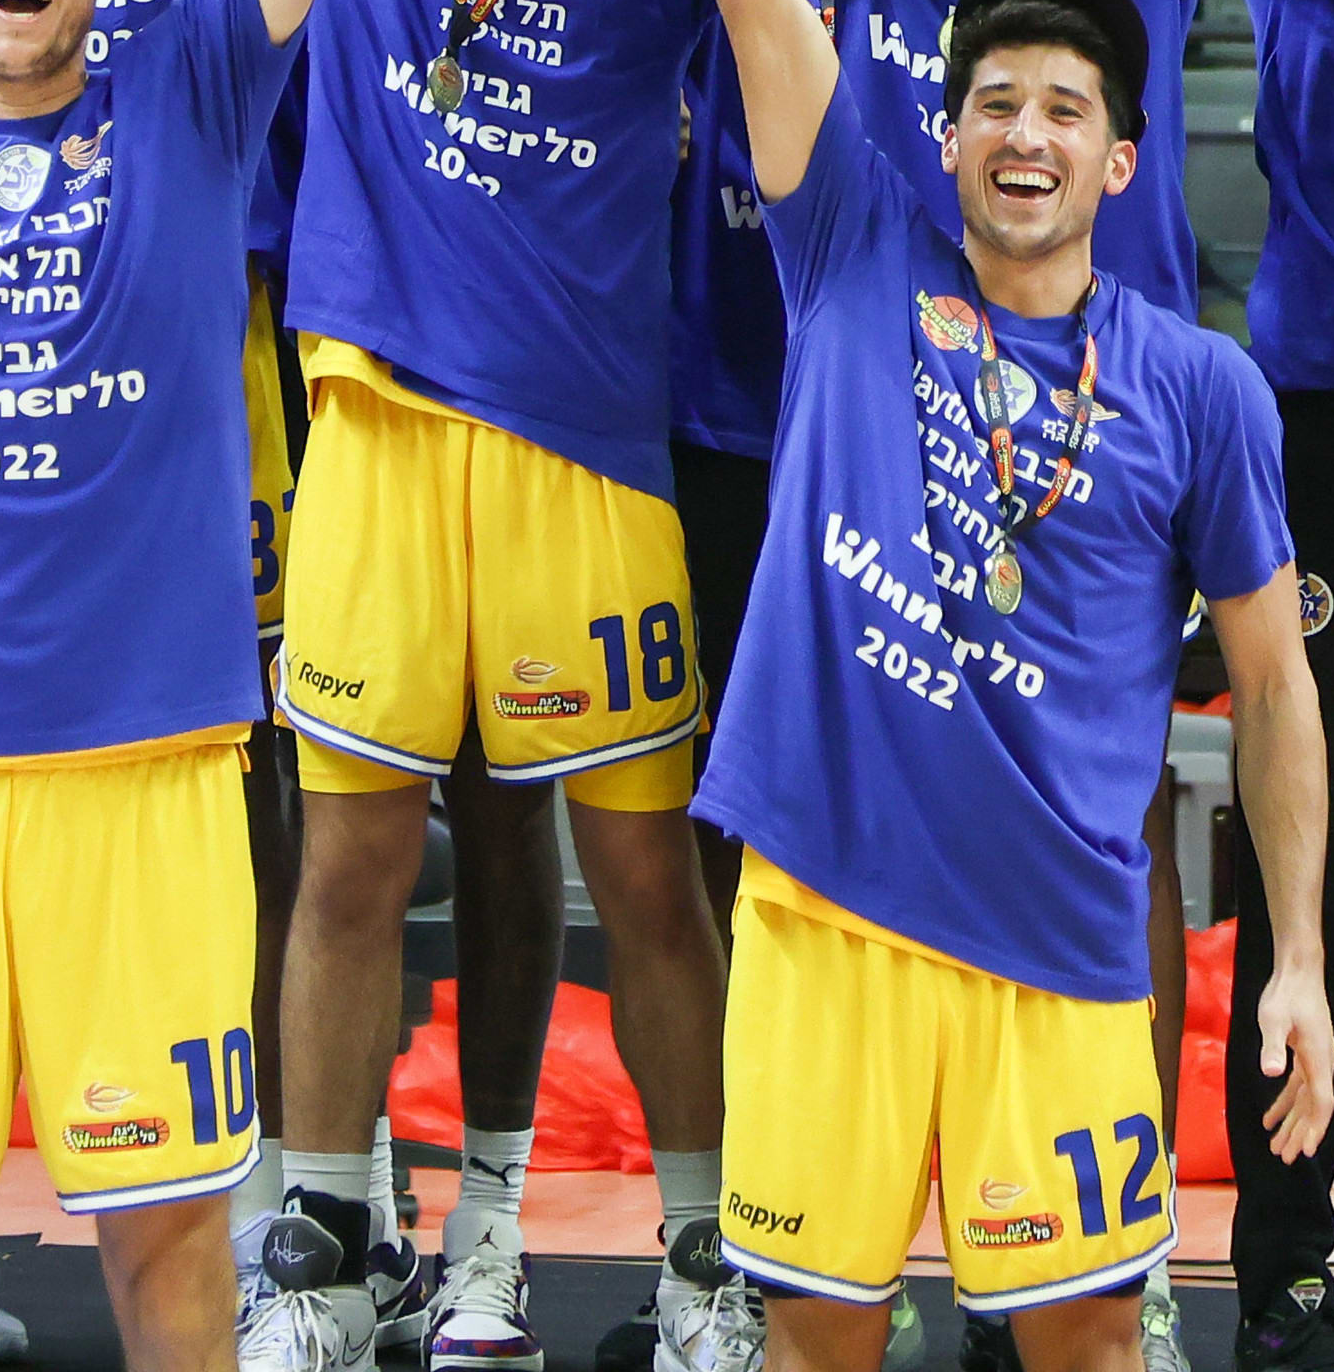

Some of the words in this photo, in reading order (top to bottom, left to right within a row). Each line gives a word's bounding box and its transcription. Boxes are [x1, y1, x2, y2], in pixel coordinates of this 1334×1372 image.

[544, 127, 598, 169] סל
[27, 245, 81, 278] תל
[89, 368, 147, 409] סל
[822, 512, 985, 668] Winnr
[988, 639, 1046, 699] סל
[588, 600, 687, 713] 18
[855, 625, 961, 712] 2022
[297, 660, 366, 700] Rapyd
[500, 697, 564, 716] Winner
[170, 1026, 255, 1146] 10
[70, 1131, 139, 1150] Winner
[1053, 1111, 1164, 1238] 12
[726, 1190, 805, 1236] Rapyd
[969, 1223, 1033, 1245] Winner
